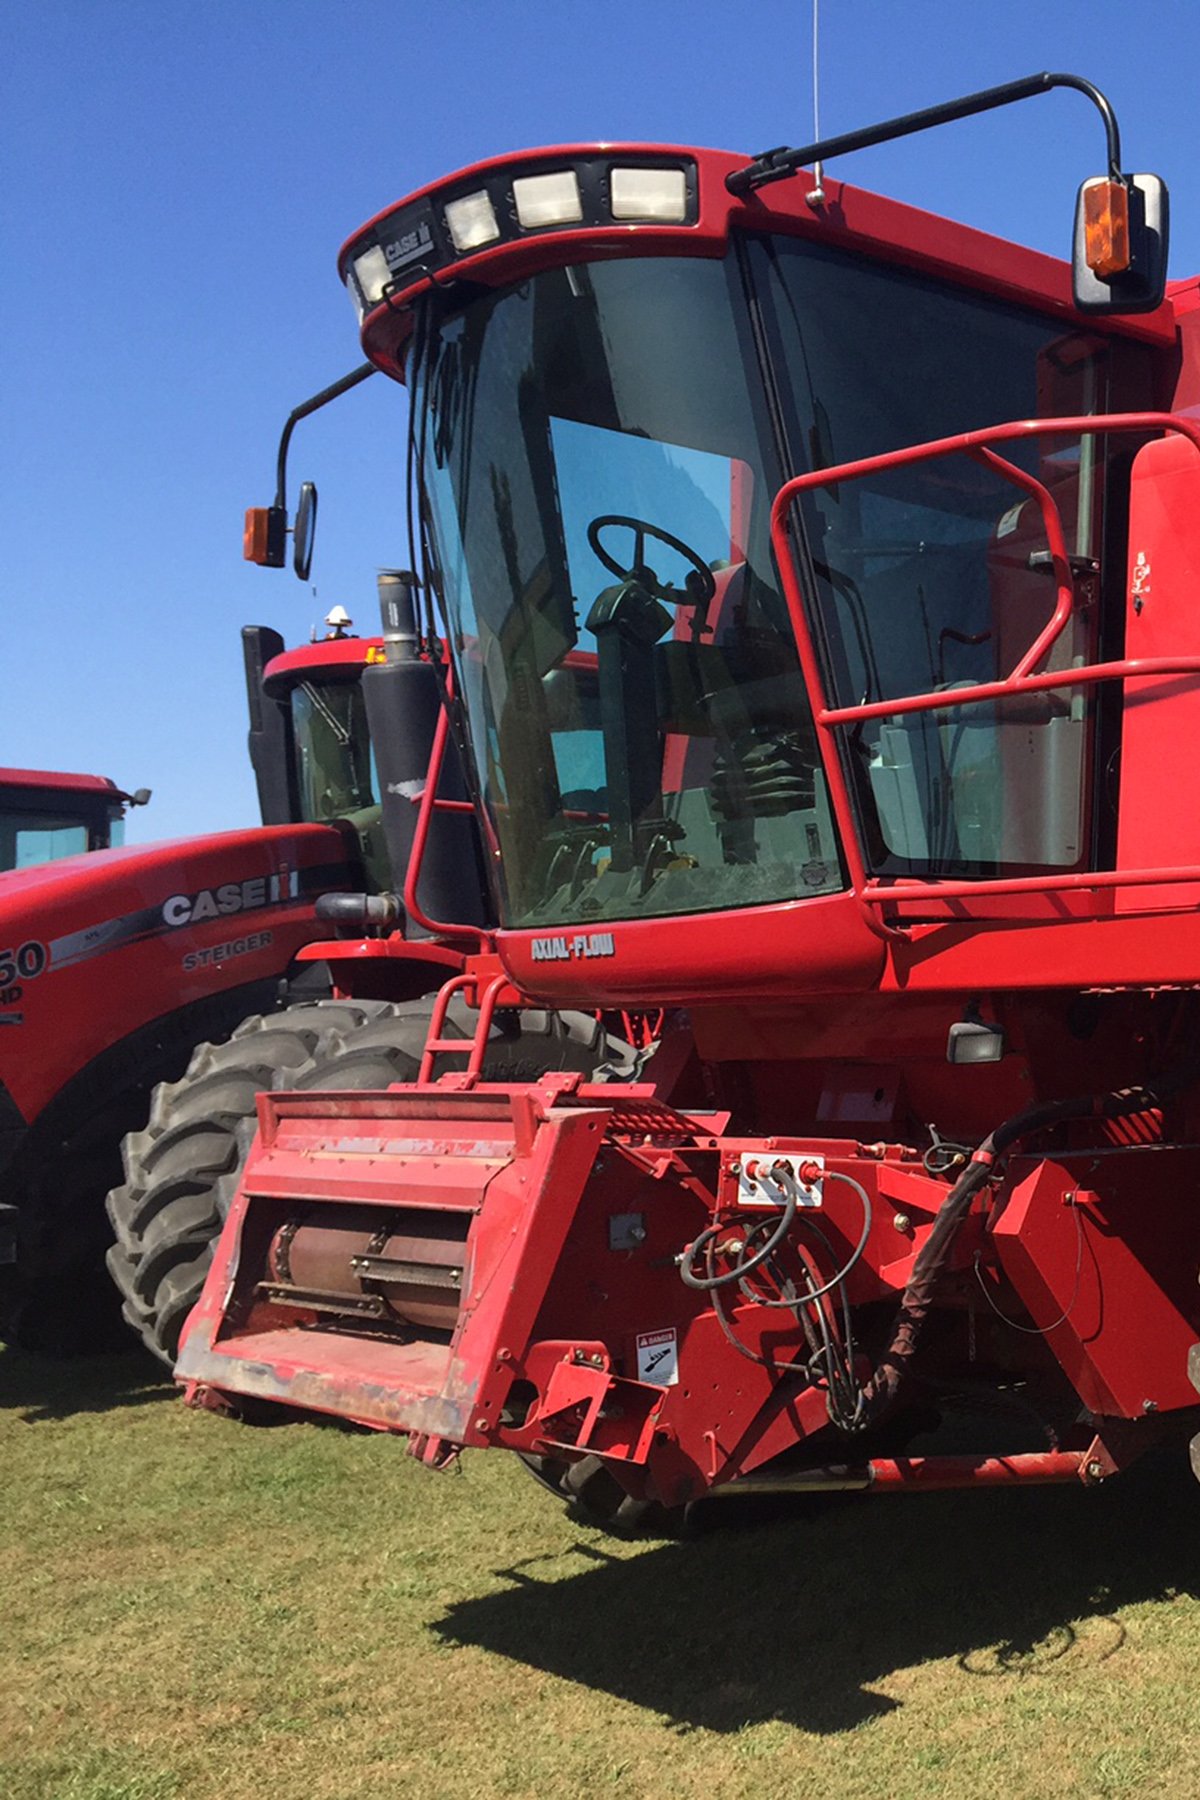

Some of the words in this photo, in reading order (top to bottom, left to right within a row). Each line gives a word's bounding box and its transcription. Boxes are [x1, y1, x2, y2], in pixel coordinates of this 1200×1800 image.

[386, 232, 418, 260] CASE
[163, 879, 265, 926] CASE
[183, 931, 273, 972] STEIGER
[531, 934, 614, 960] AXIAL-FLOW
